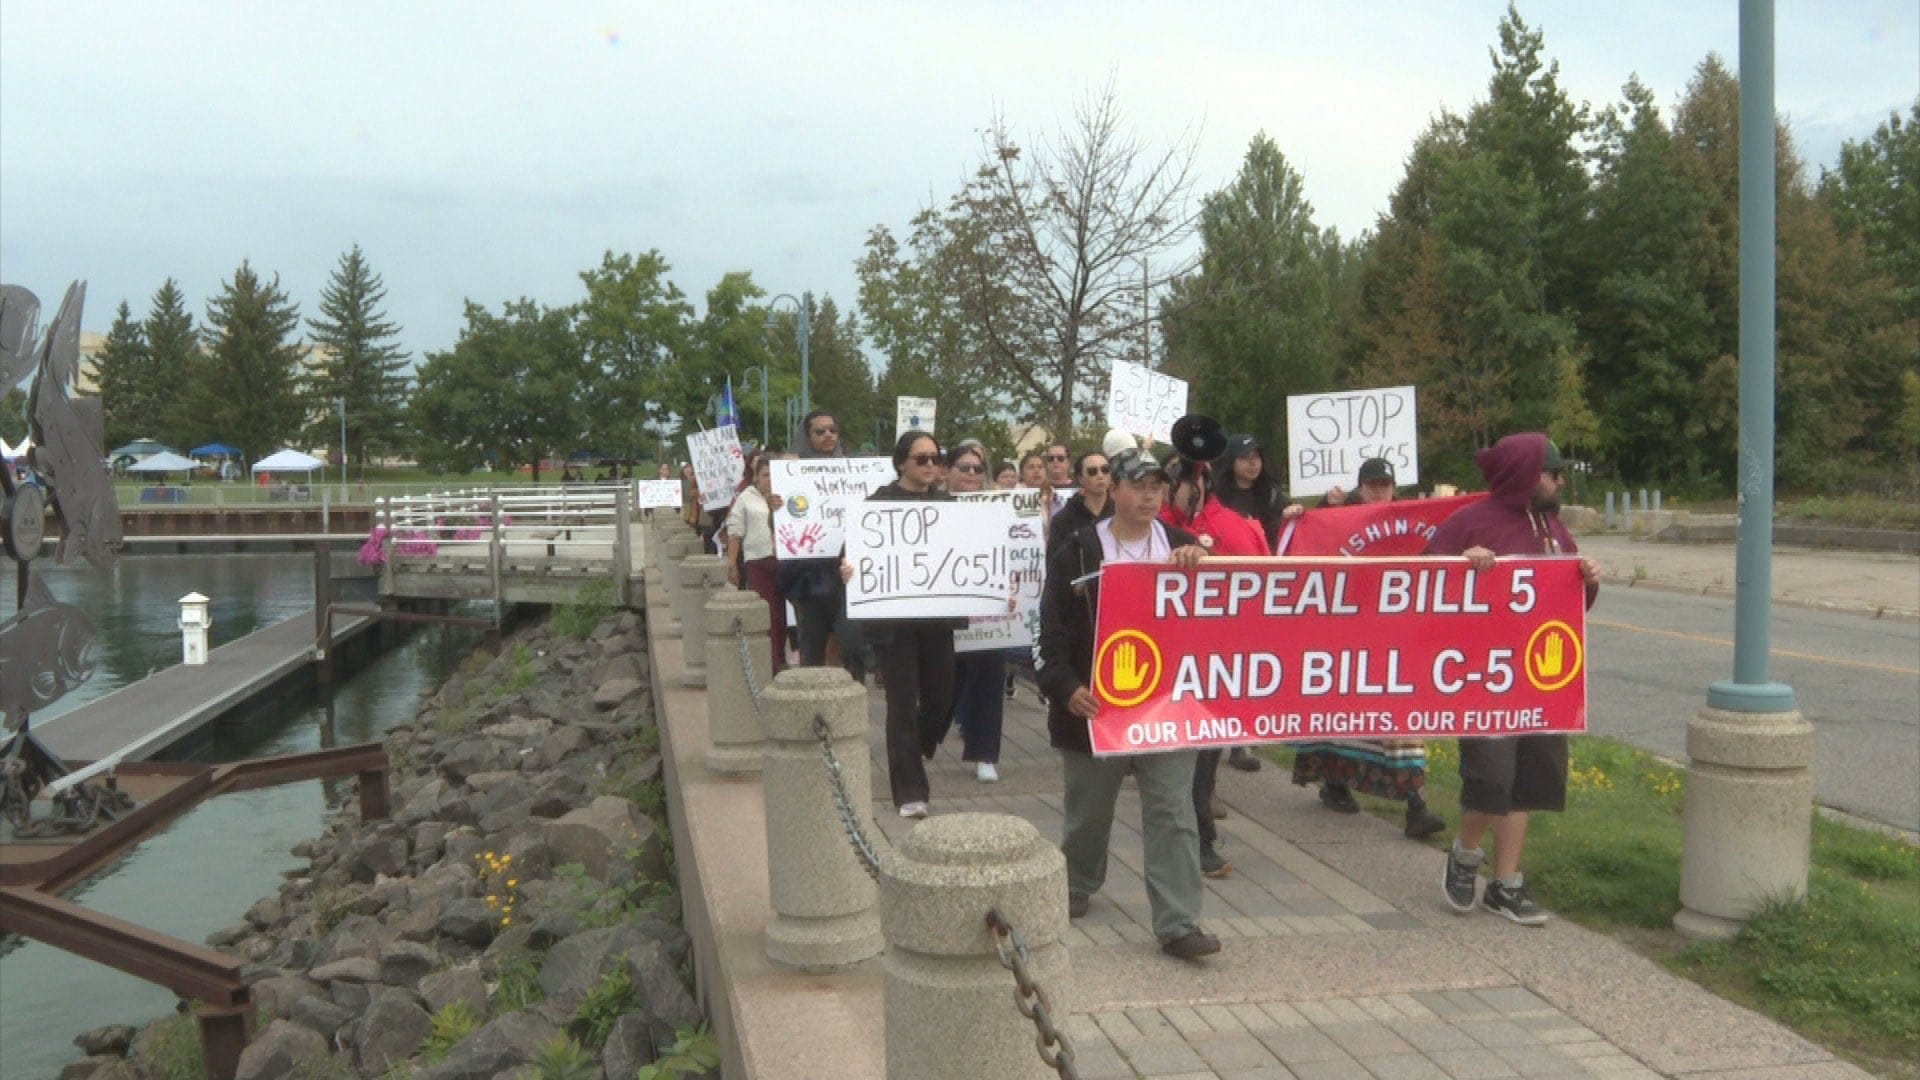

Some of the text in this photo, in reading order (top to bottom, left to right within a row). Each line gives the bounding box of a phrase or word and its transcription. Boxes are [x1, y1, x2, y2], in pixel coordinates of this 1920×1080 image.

[1129, 365, 1178, 400] STOP
[1306, 394, 1404, 444] STOP
[786, 459, 884, 476] Communities
[1299, 446, 1350, 480] BILL
[861, 505, 940, 549] STOP
[859, 544, 1006, 594] Bill 5/C5!!
[1154, 569, 1537, 619] REPEAL BILL 5
[1171, 647, 1515, 702] AND BILL C-5
[1126, 706, 1550, 746] OUR LAND. OUR RIGHTS. OUR FUTURE.
